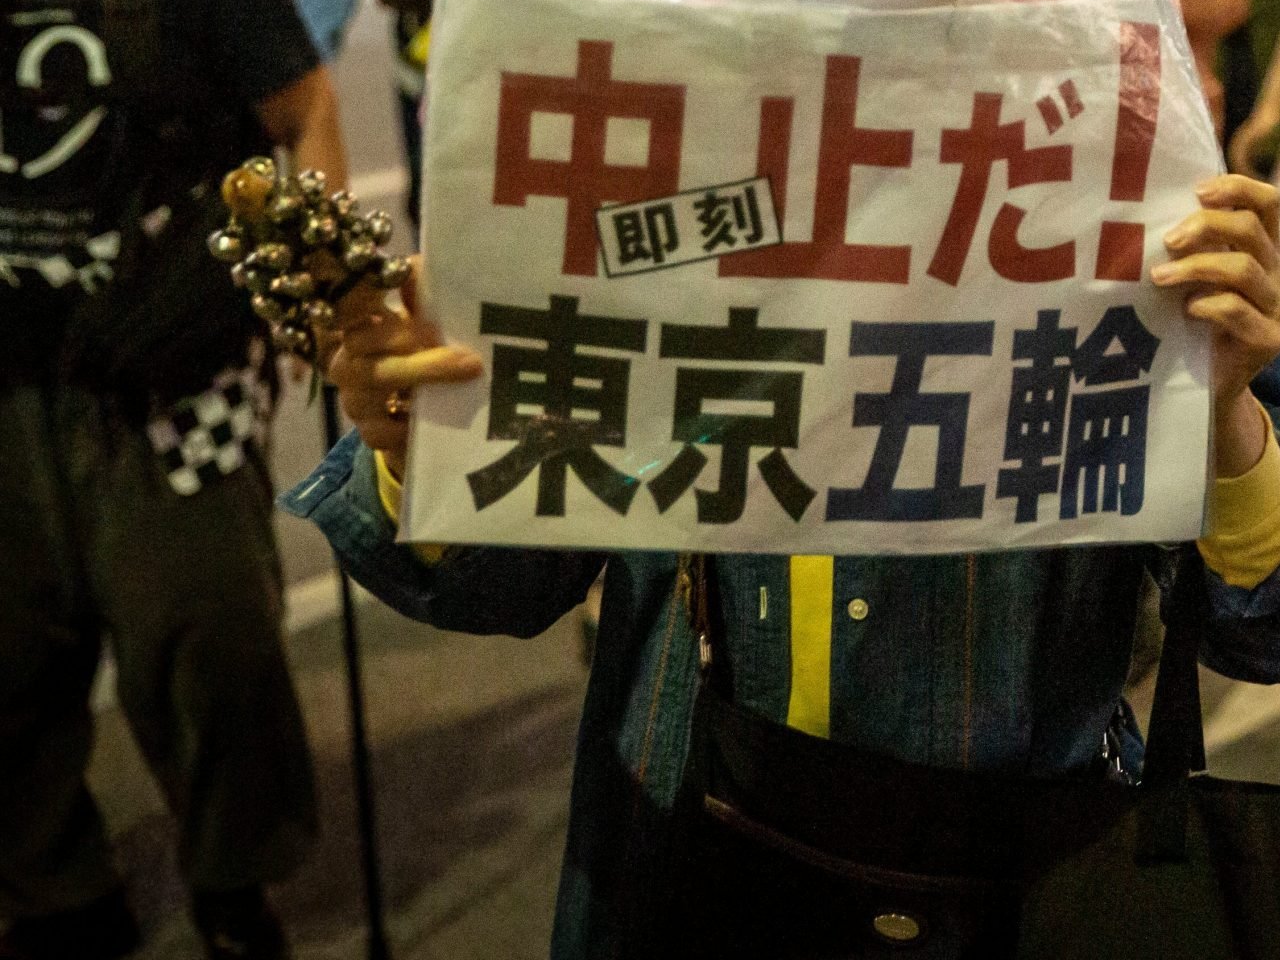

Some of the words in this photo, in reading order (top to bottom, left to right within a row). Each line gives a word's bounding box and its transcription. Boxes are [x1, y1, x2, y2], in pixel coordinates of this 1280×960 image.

[492, 20, 1162, 287] 中止だ!
[610, 183, 764, 267] 即刻
[466, 294, 1161, 526] 東京五輪
